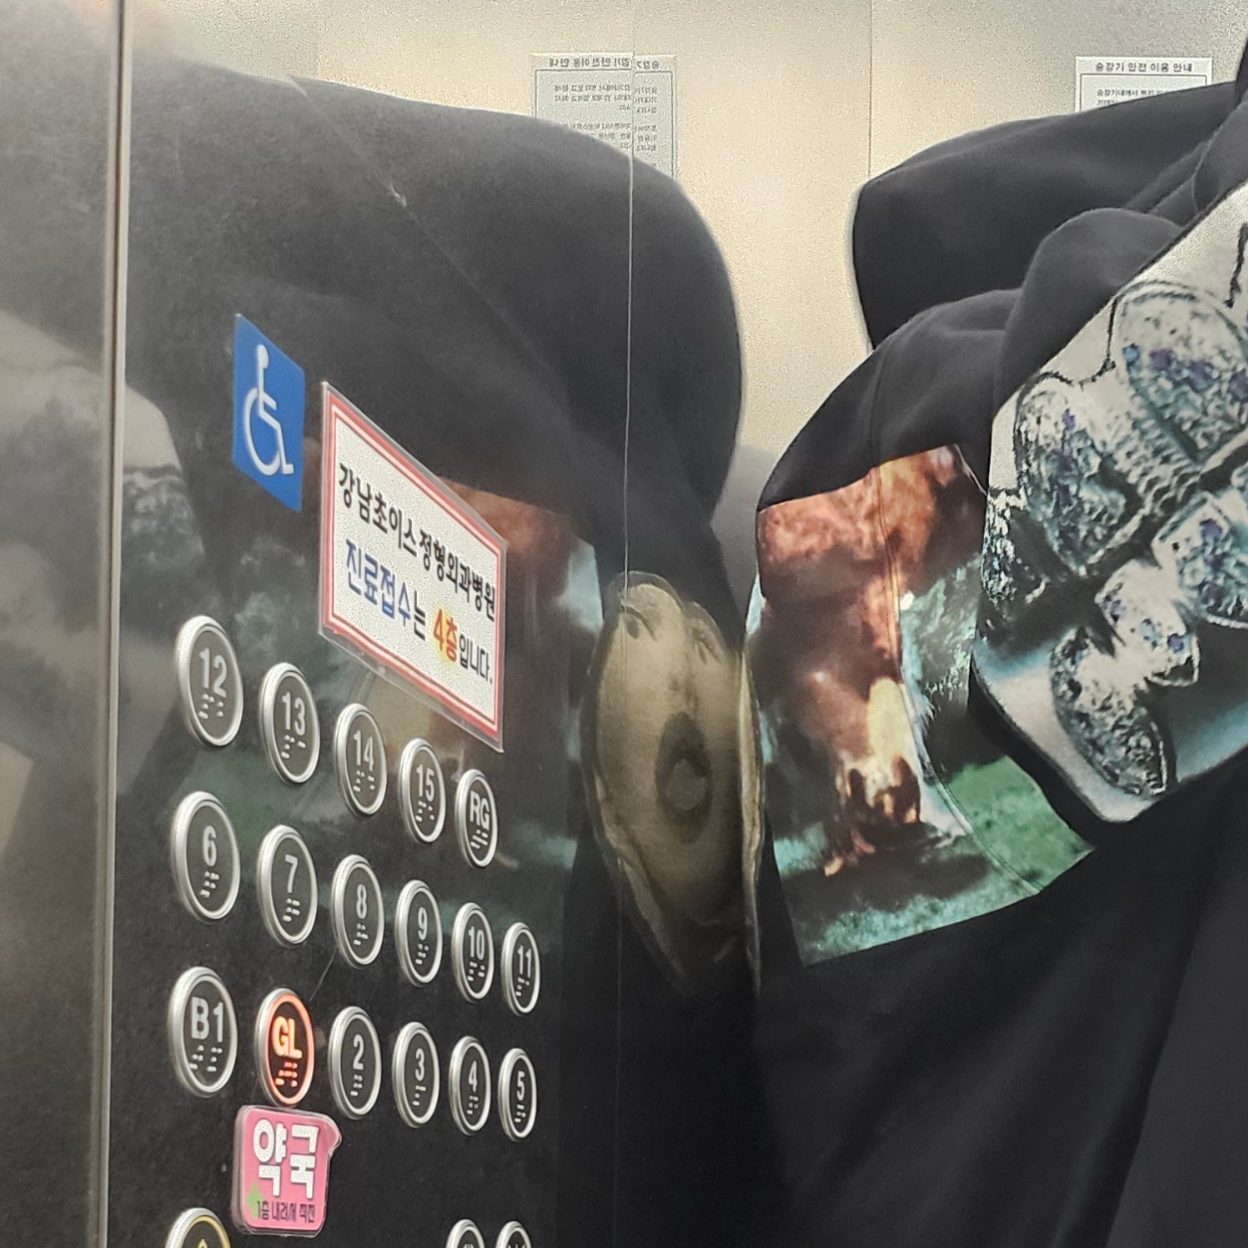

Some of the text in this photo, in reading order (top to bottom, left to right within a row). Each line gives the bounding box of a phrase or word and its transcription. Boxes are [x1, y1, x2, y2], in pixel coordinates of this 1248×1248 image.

[1095, 63, 1192, 72] 승강기 안전 이용 안내
[346, 538, 492, 685] 진료접수는 4층입니다.
[200, 648, 227, 698] 12
[282, 691, 306, 736] 13
[354, 730, 374, 772] 14
[416, 763, 434, 802] 15
[469, 790, 490, 832] RG
[203, 825, 217, 866] 6
[285, 854, 298, 893] 7
[356, 884, 367, 920] 8
[418, 906, 428, 941] 9
[468, 927, 485, 960] 10
[517, 946, 532, 979] 11
[191, 997, 224, 1043] B1
[272, 1016, 302, 1059] GL
[353, 1034, 364, 1071] 2
[415, 1048, 425, 1081] 3
[468, 1060, 478, 1092] 4
[516, 1070, 525, 1101] 5
[252, 1118, 319, 1199] 약국
[257, 1200, 269, 1220] 1층
[272, 1202, 296, 1222] 내려서
